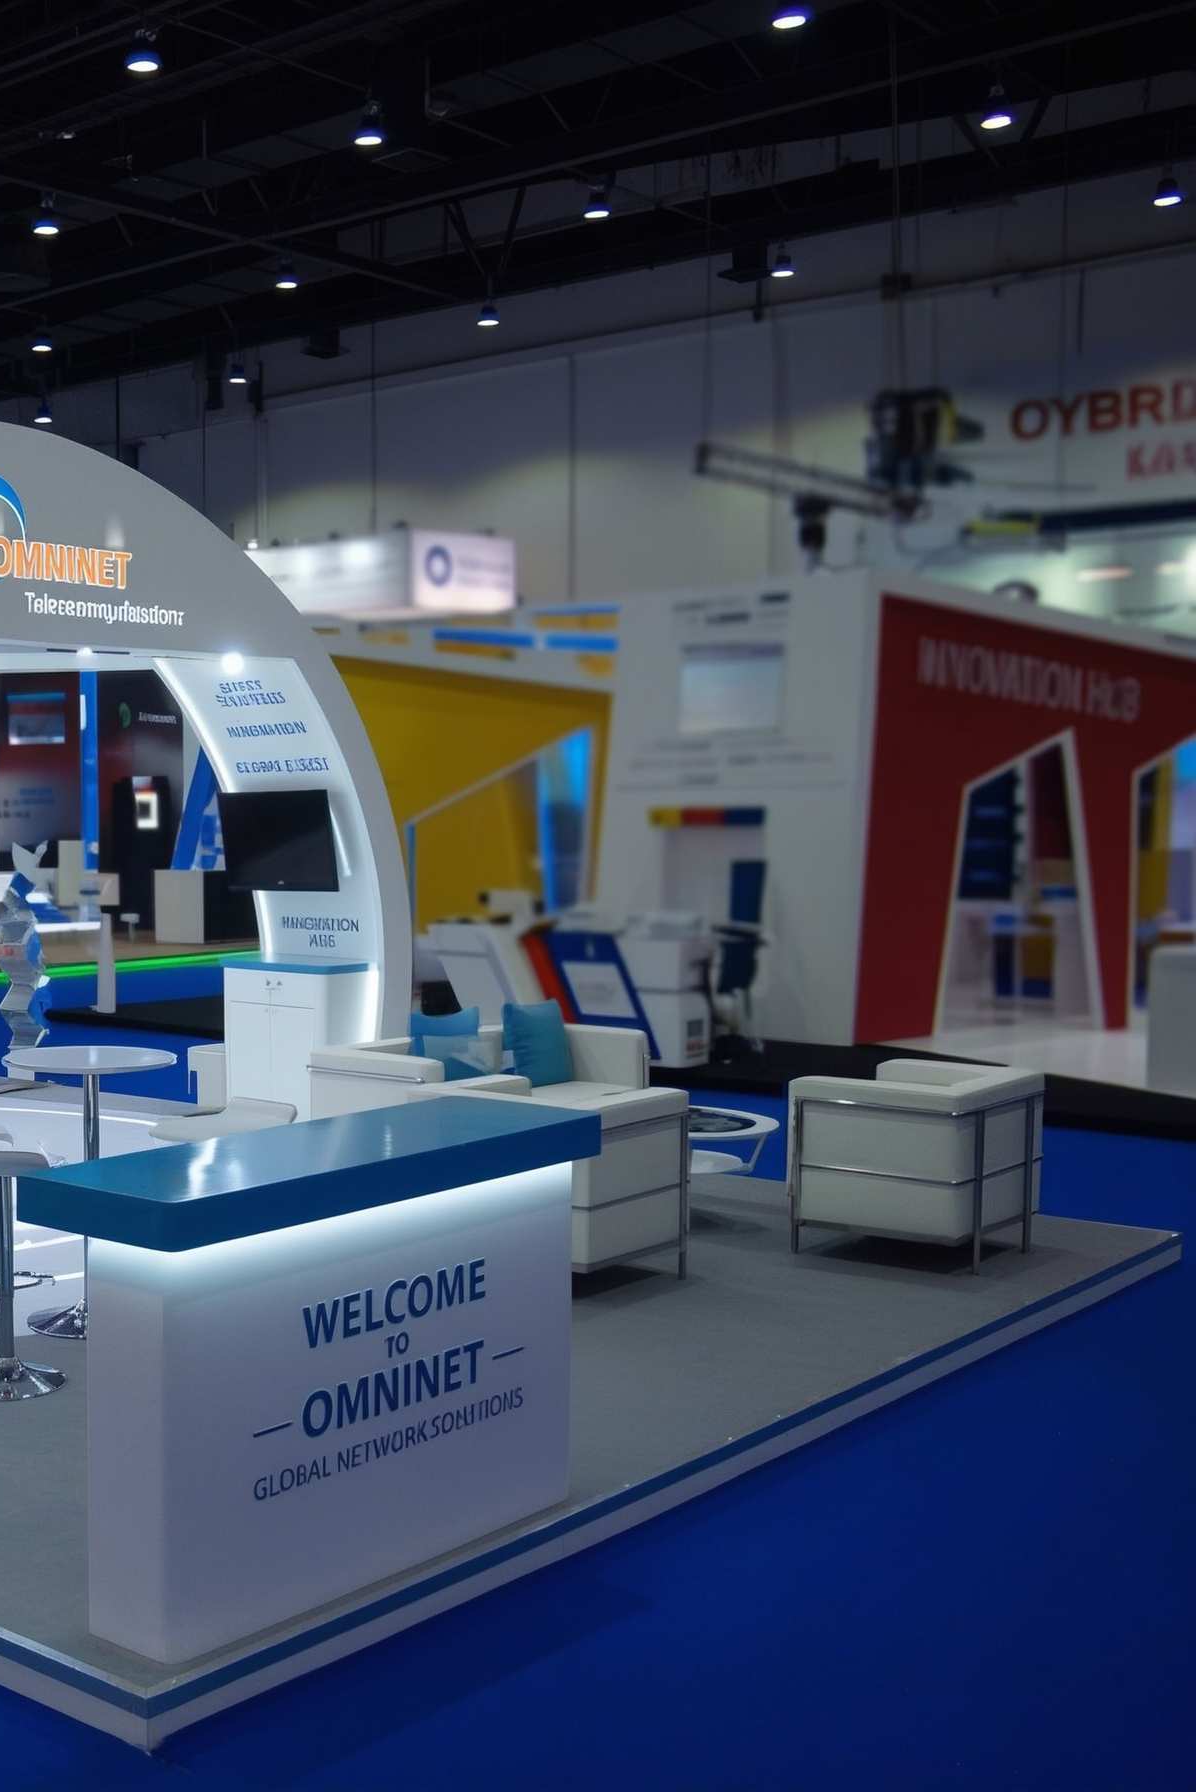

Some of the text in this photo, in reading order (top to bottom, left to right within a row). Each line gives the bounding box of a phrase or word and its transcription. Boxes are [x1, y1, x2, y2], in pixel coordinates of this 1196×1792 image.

[301, 1256, 486, 1349] WELCOME
[384, 1331, 410, 1359] TO
[302, 1339, 484, 1438] OMNINET
[253, 1455, 331, 1501] GLOBAL
